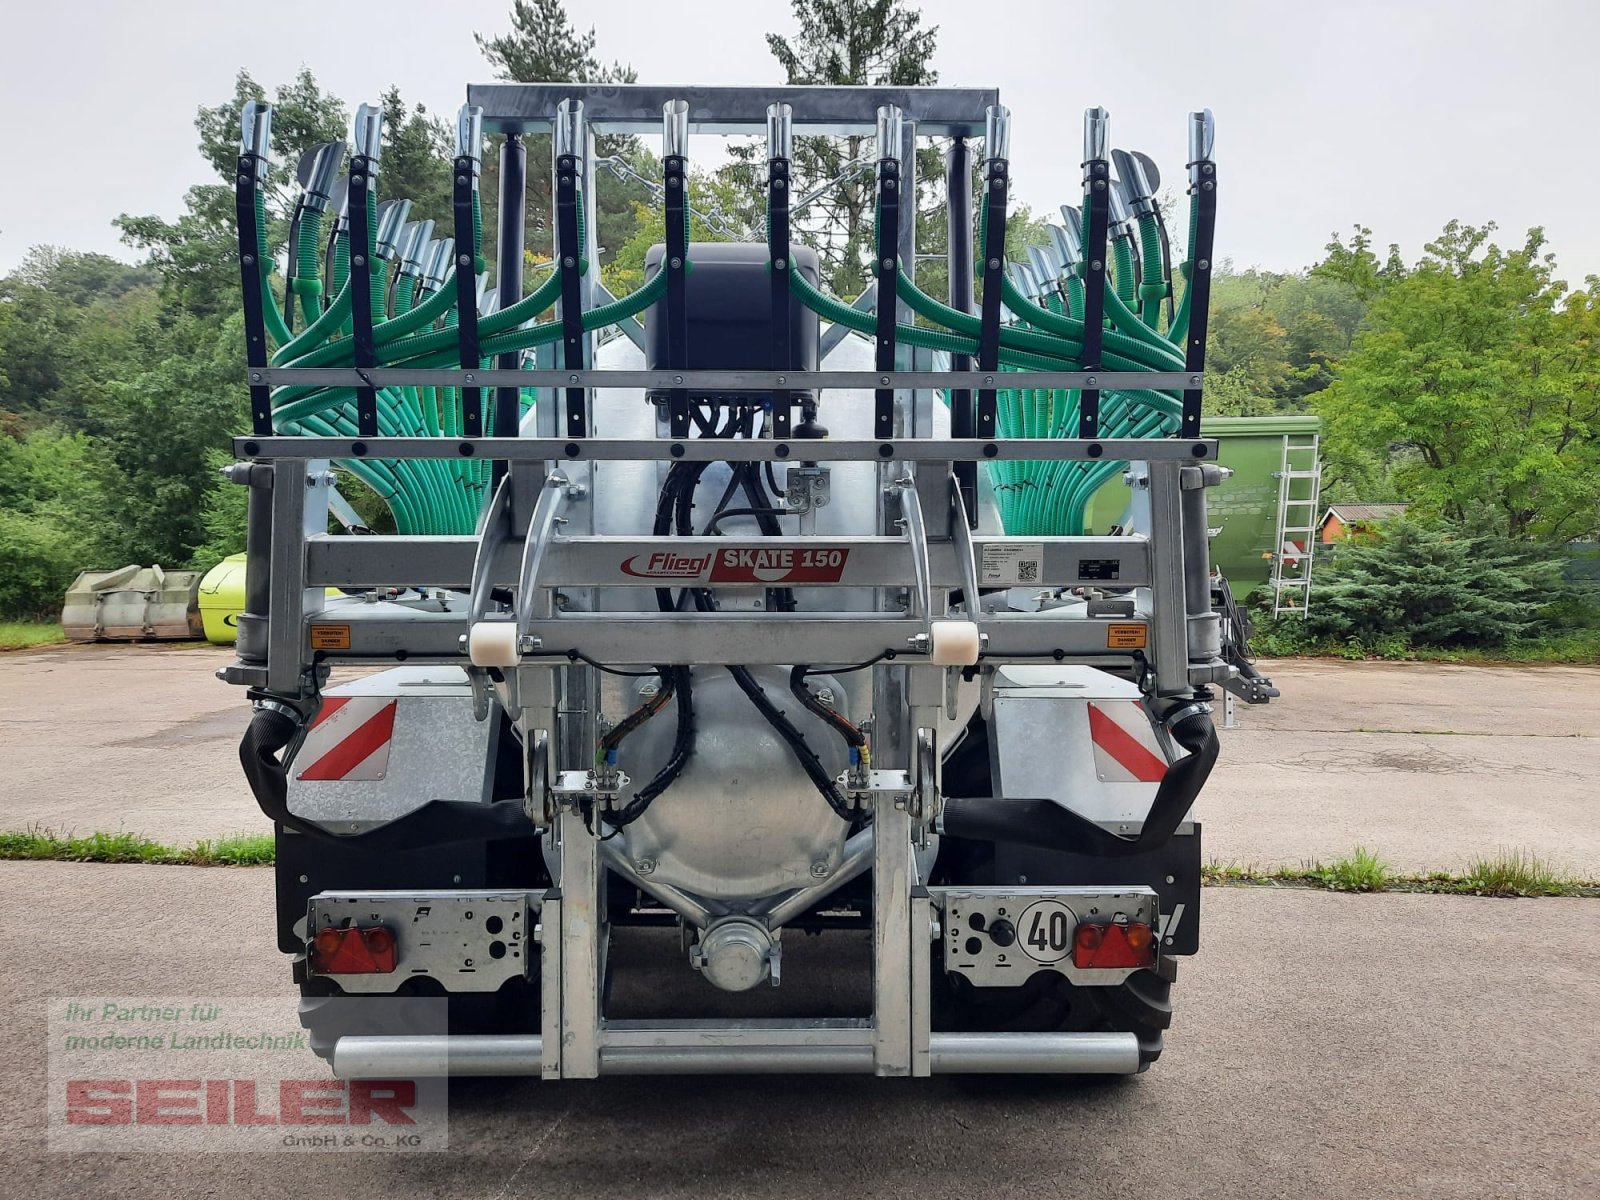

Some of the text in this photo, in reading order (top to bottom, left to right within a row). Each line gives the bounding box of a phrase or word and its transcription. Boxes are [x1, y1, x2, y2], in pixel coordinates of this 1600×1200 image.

[648, 552, 713, 574] Fliegl
[723, 550, 843, 568] SKATE 150
[1026, 911, 1068, 952] 40
